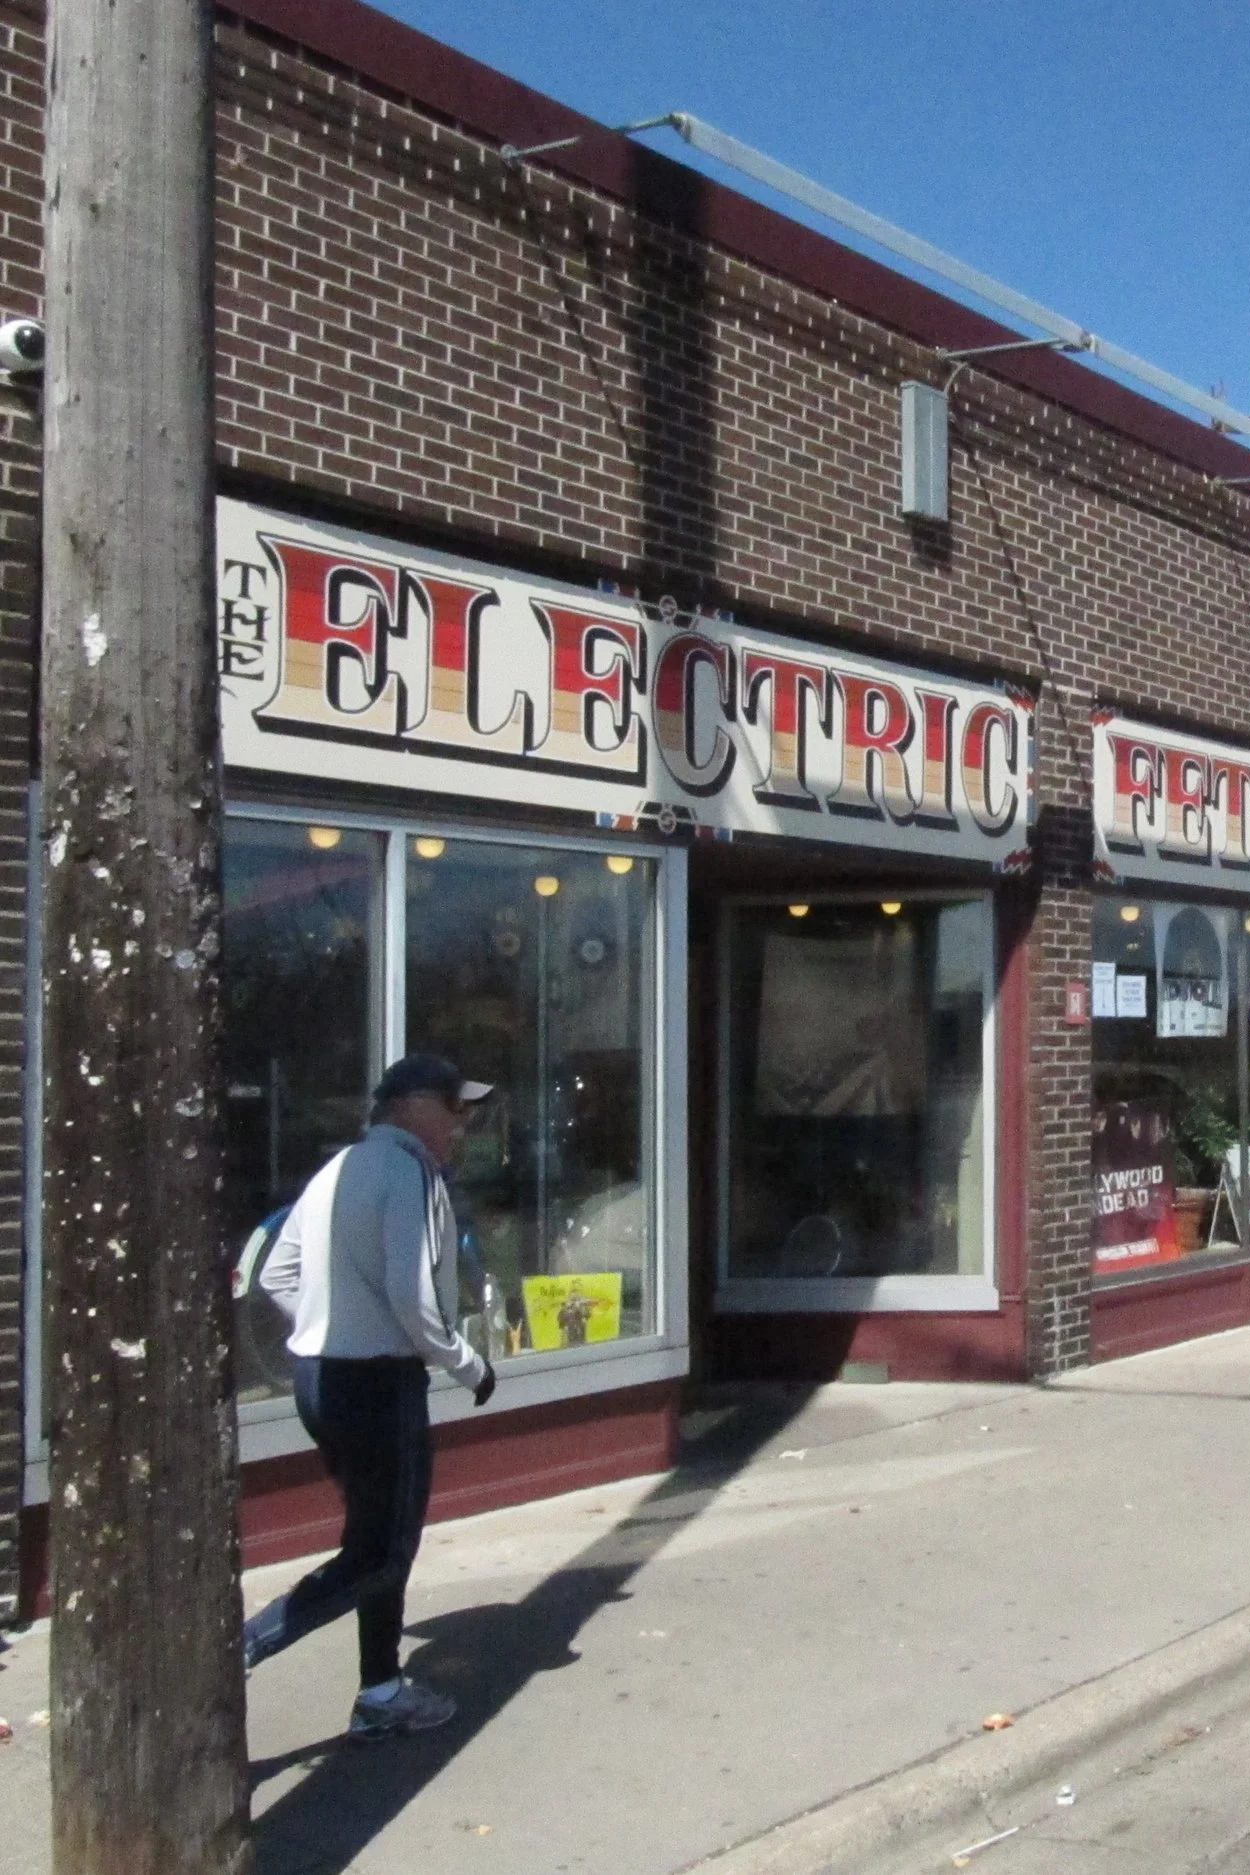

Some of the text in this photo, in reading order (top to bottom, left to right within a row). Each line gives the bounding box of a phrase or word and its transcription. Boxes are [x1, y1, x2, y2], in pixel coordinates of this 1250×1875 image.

[218, 558, 271, 681] THE
[254, 531, 1019, 837] ELECTRIC
[1098, 1189, 1149, 1215] DEAD
